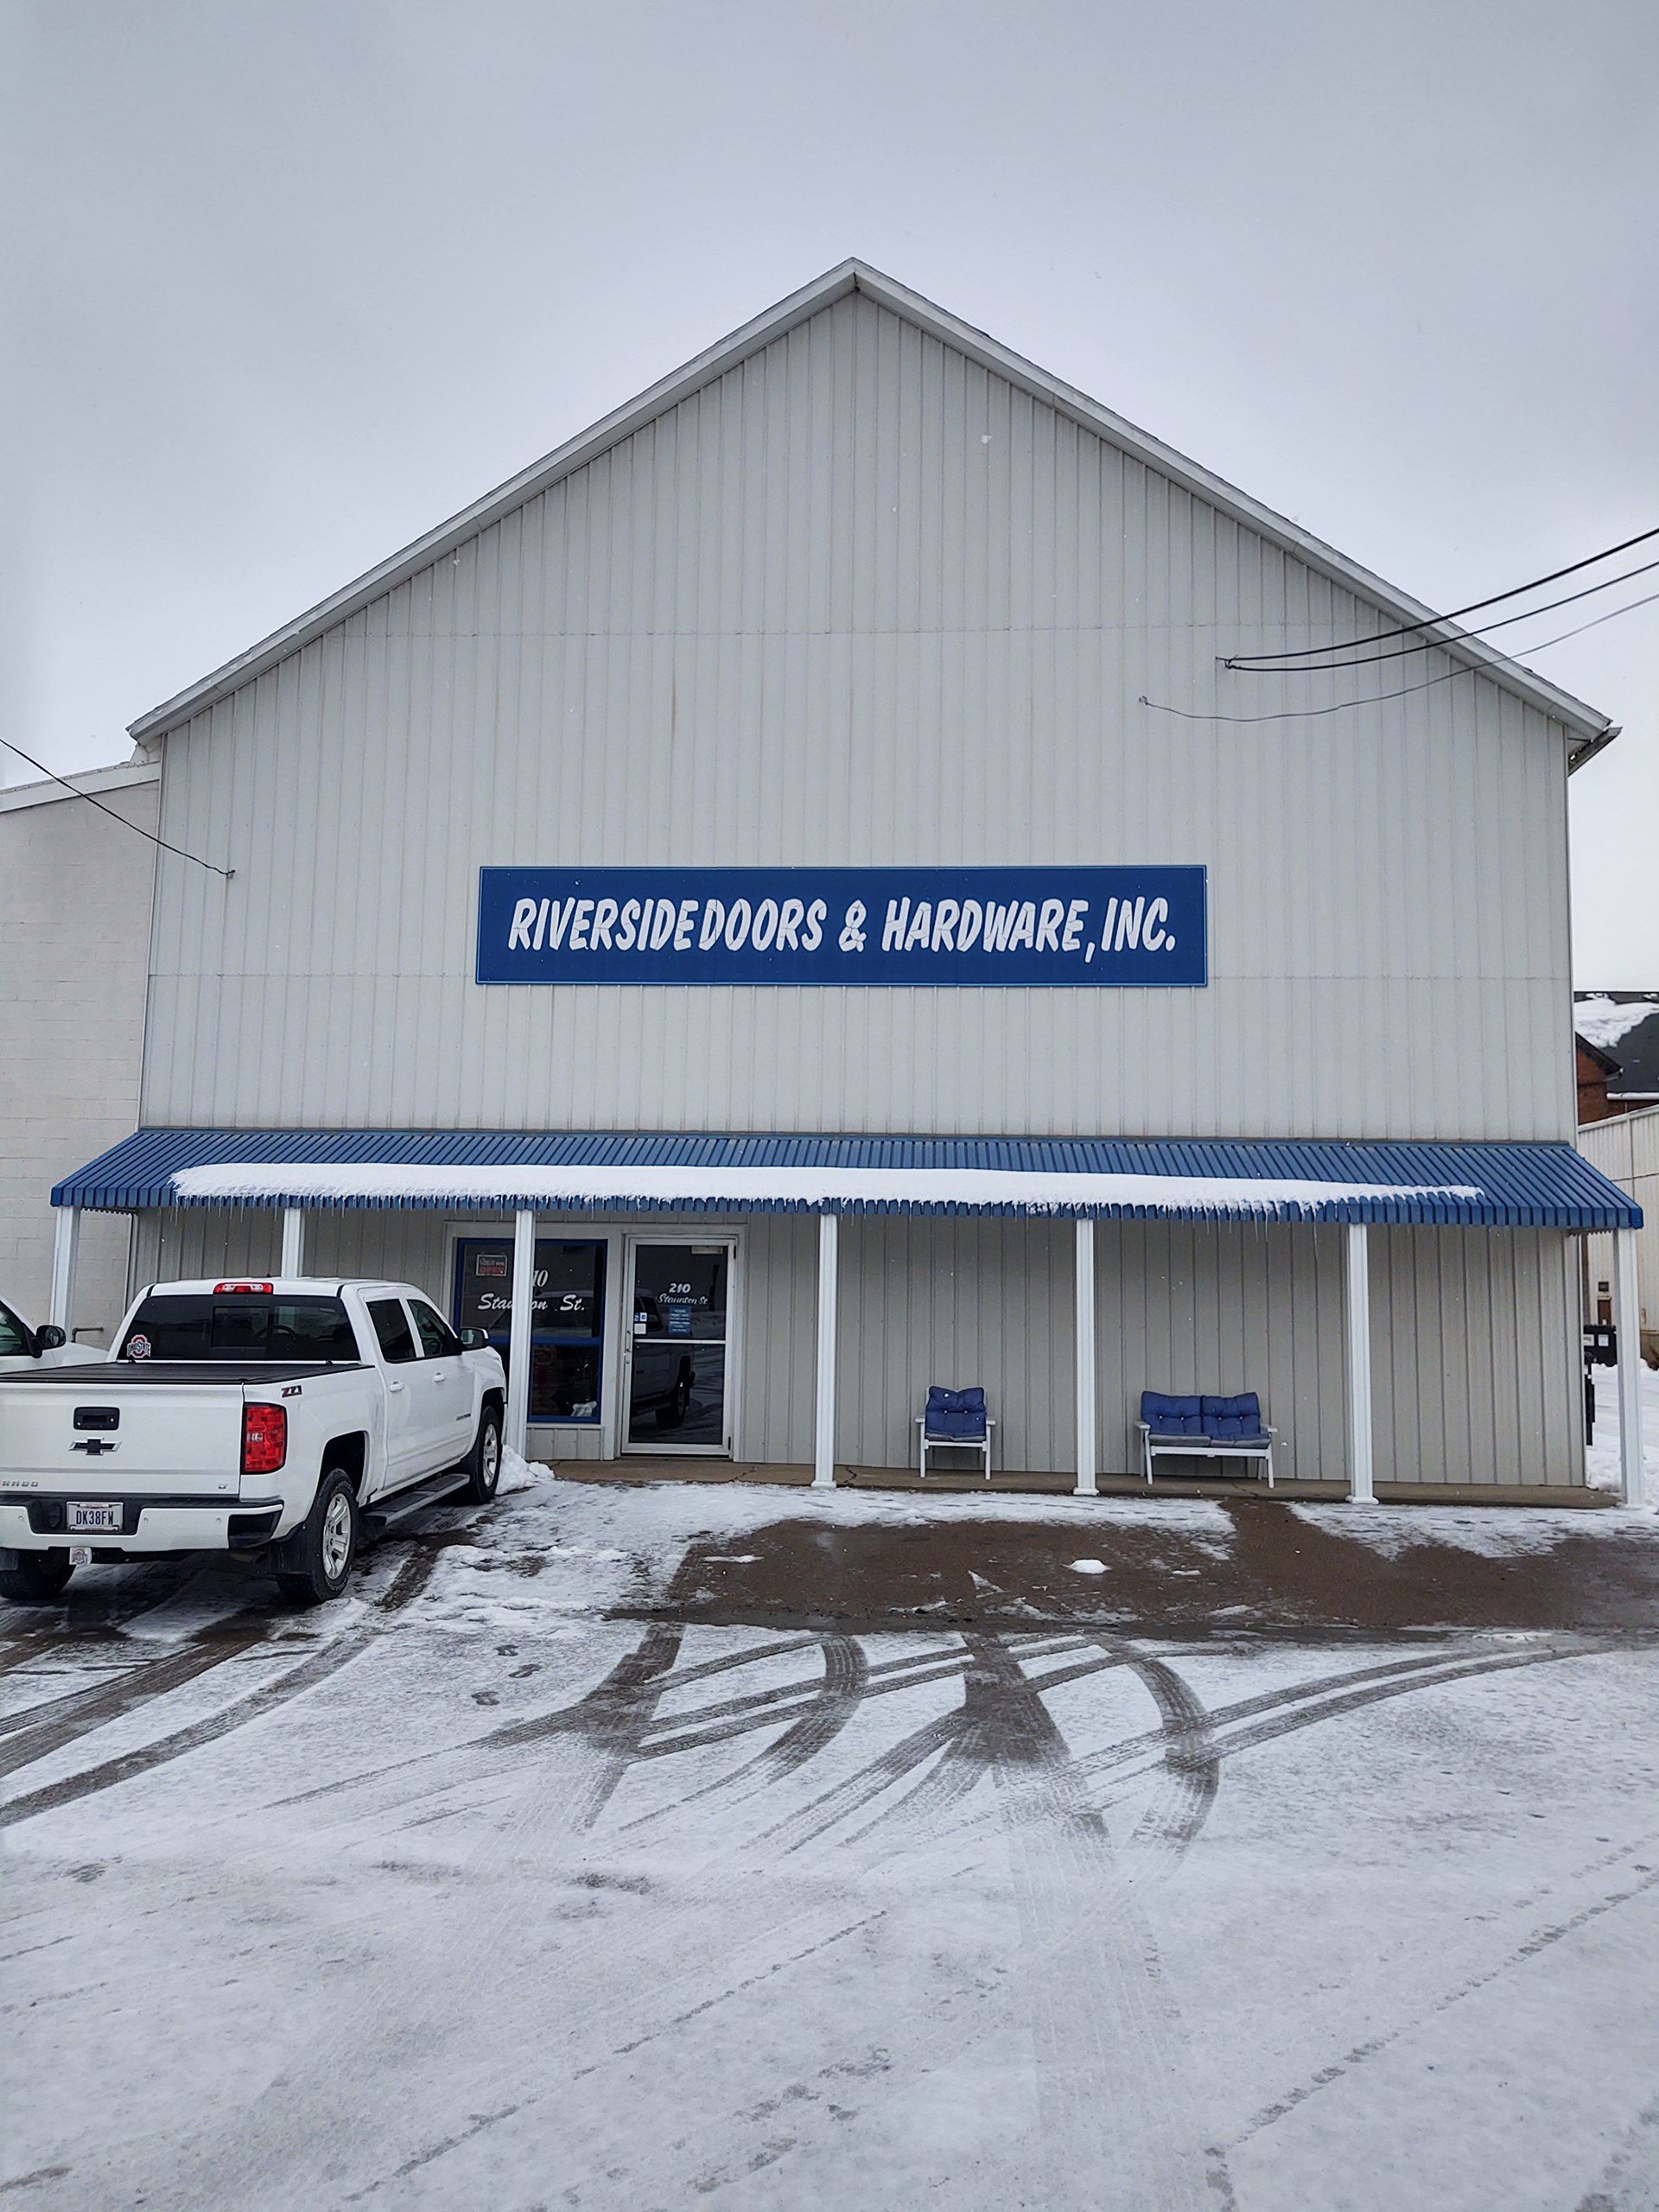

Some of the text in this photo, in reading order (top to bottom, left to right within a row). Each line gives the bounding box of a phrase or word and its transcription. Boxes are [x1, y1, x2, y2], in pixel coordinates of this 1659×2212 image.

[838, 899, 867, 952] &
[532, 1269, 548, 1287] 10
[669, 1282, 691, 1294] 210
[559, 1294, 585, 1311] St.
[658, 1293, 697, 1305] Staunton
[281, 1385, 302, 1398] Z71
